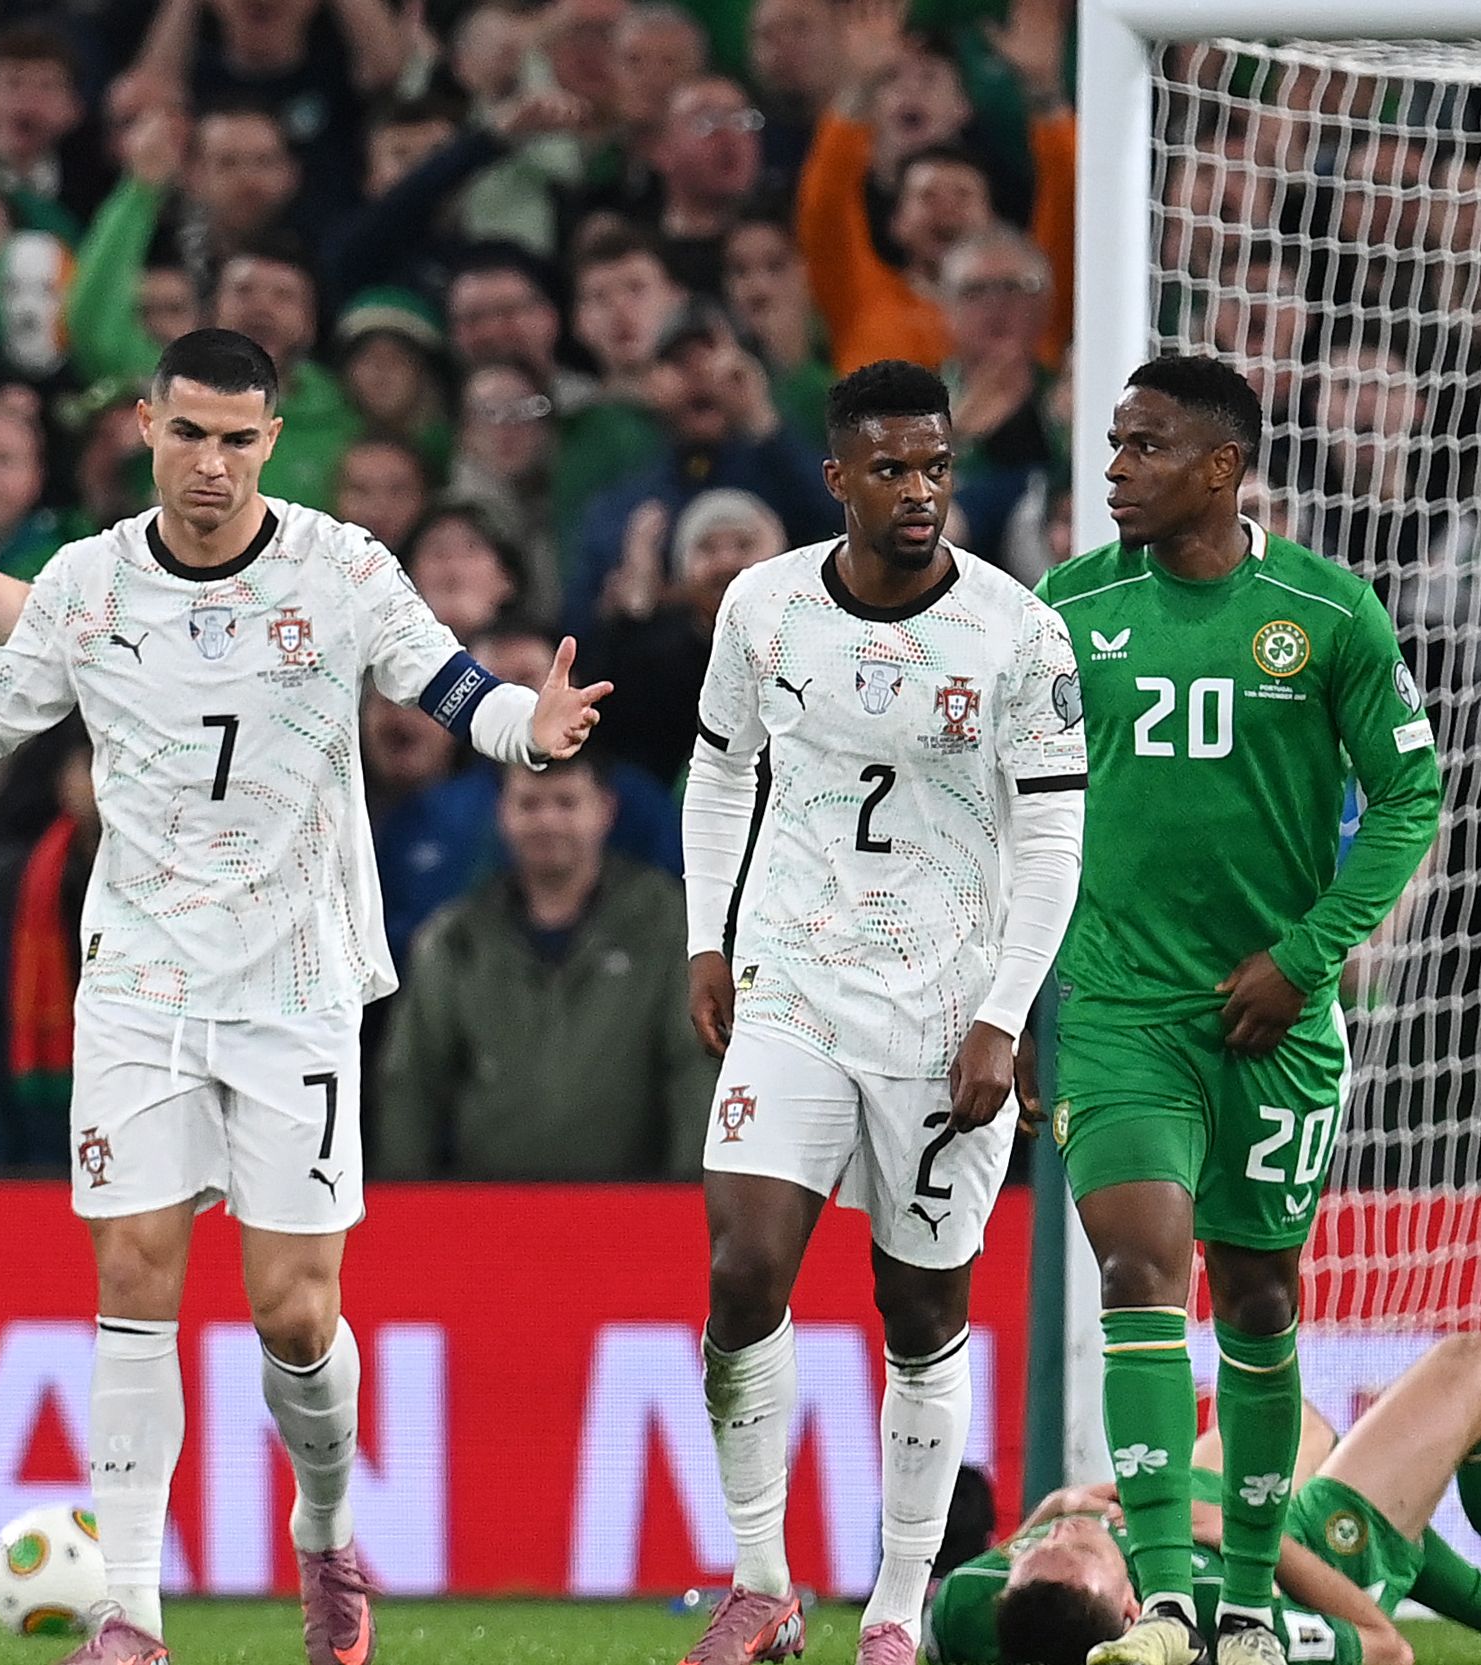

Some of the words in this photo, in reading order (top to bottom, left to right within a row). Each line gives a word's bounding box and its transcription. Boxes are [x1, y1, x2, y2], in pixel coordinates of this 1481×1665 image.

[442, 669, 481, 717] RESPECT
[1134, 677, 1234, 759] 20
[202, 714, 240, 801] 7
[855, 764, 896, 854] 2
[302, 1071, 338, 1160] 7
[915, 1111, 957, 1200] 2
[1245, 1104, 1335, 1185] 20
